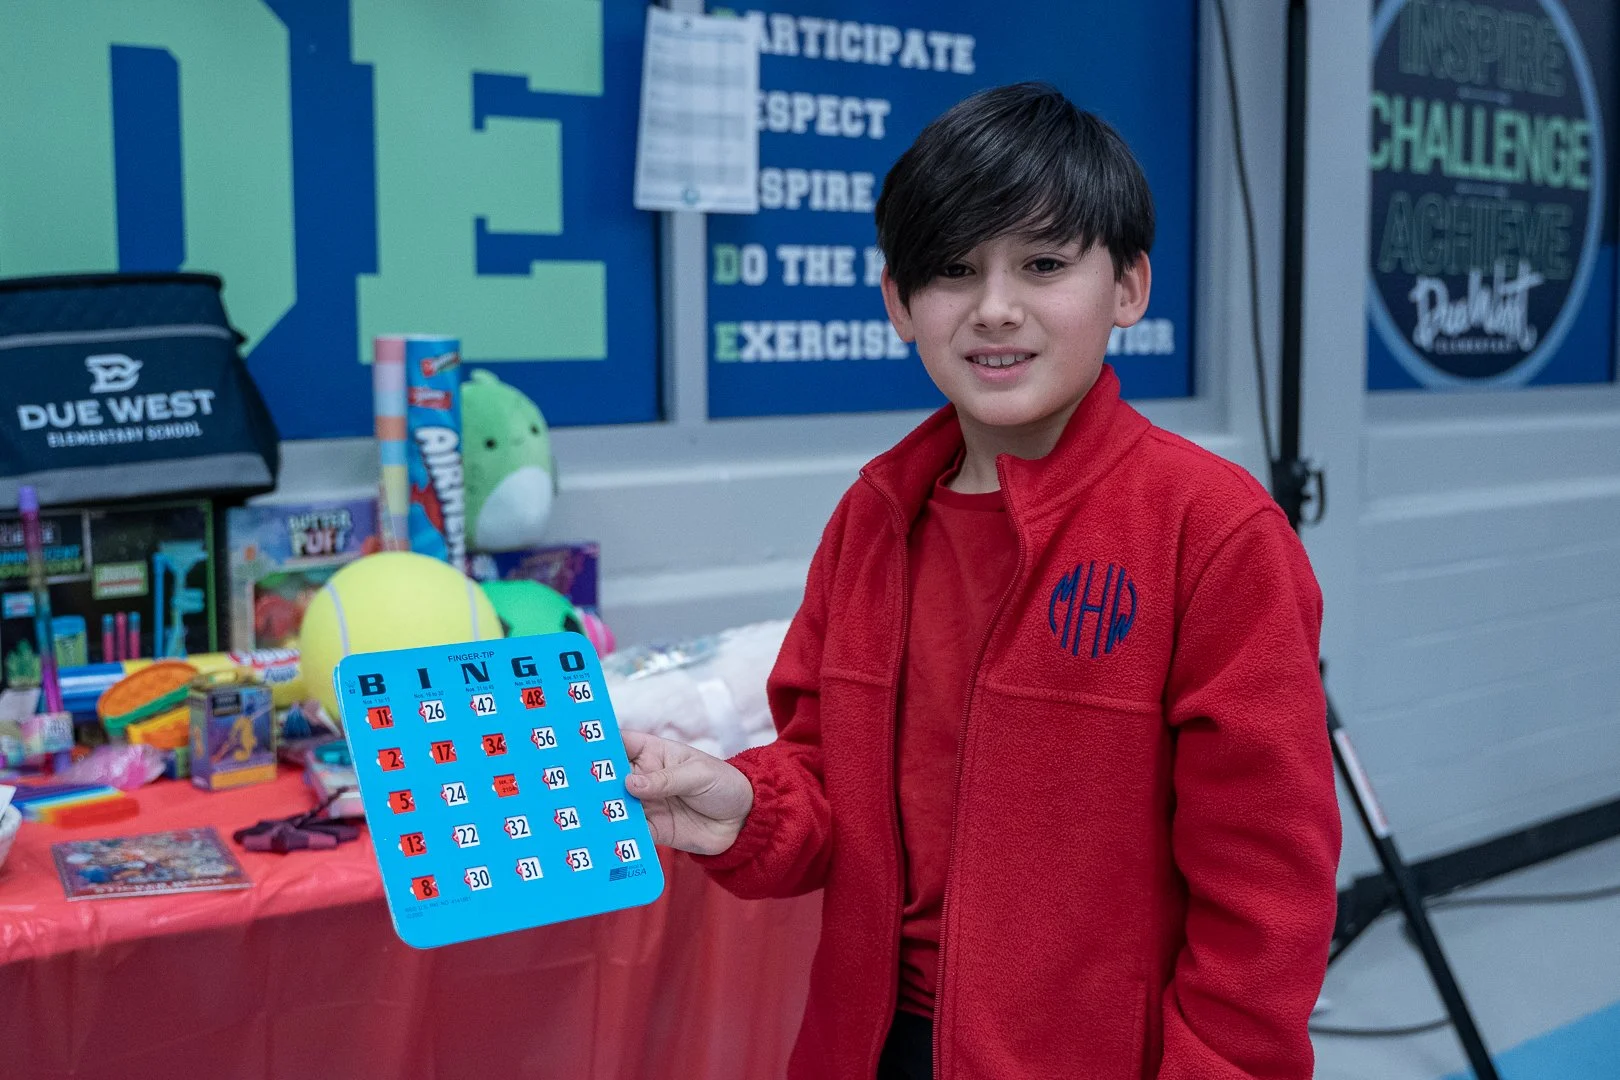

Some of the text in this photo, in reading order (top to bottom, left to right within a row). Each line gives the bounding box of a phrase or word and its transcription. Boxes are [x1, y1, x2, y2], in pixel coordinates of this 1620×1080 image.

[713, 7, 976, 75] ARTICIPATE
[757, 90, 891, 139] SPECT
[1370, 90, 1592, 190] CHALLENGE
[760, 168, 876, 213] SPIRE
[713, 243, 768, 286] DO
[776, 244, 857, 288] THE
[17, 388, 216, 431] DUE WEST
[46, 420, 203, 448] ELEMENTARY SCHOOL
[447, 651, 495, 663] FINGER-TIP
[376, 684, 591, 726] 11 26 42 48 66
[388, 723, 601, 767] 2 17 34 56 65
[549, 762, 614, 786] 49 74
[399, 785, 466, 810] 5 24
[406, 801, 625, 853] 13 22 32 54 63
[421, 843, 636, 896] 8 30 31 53 61
[627, 867, 647, 878] USA
